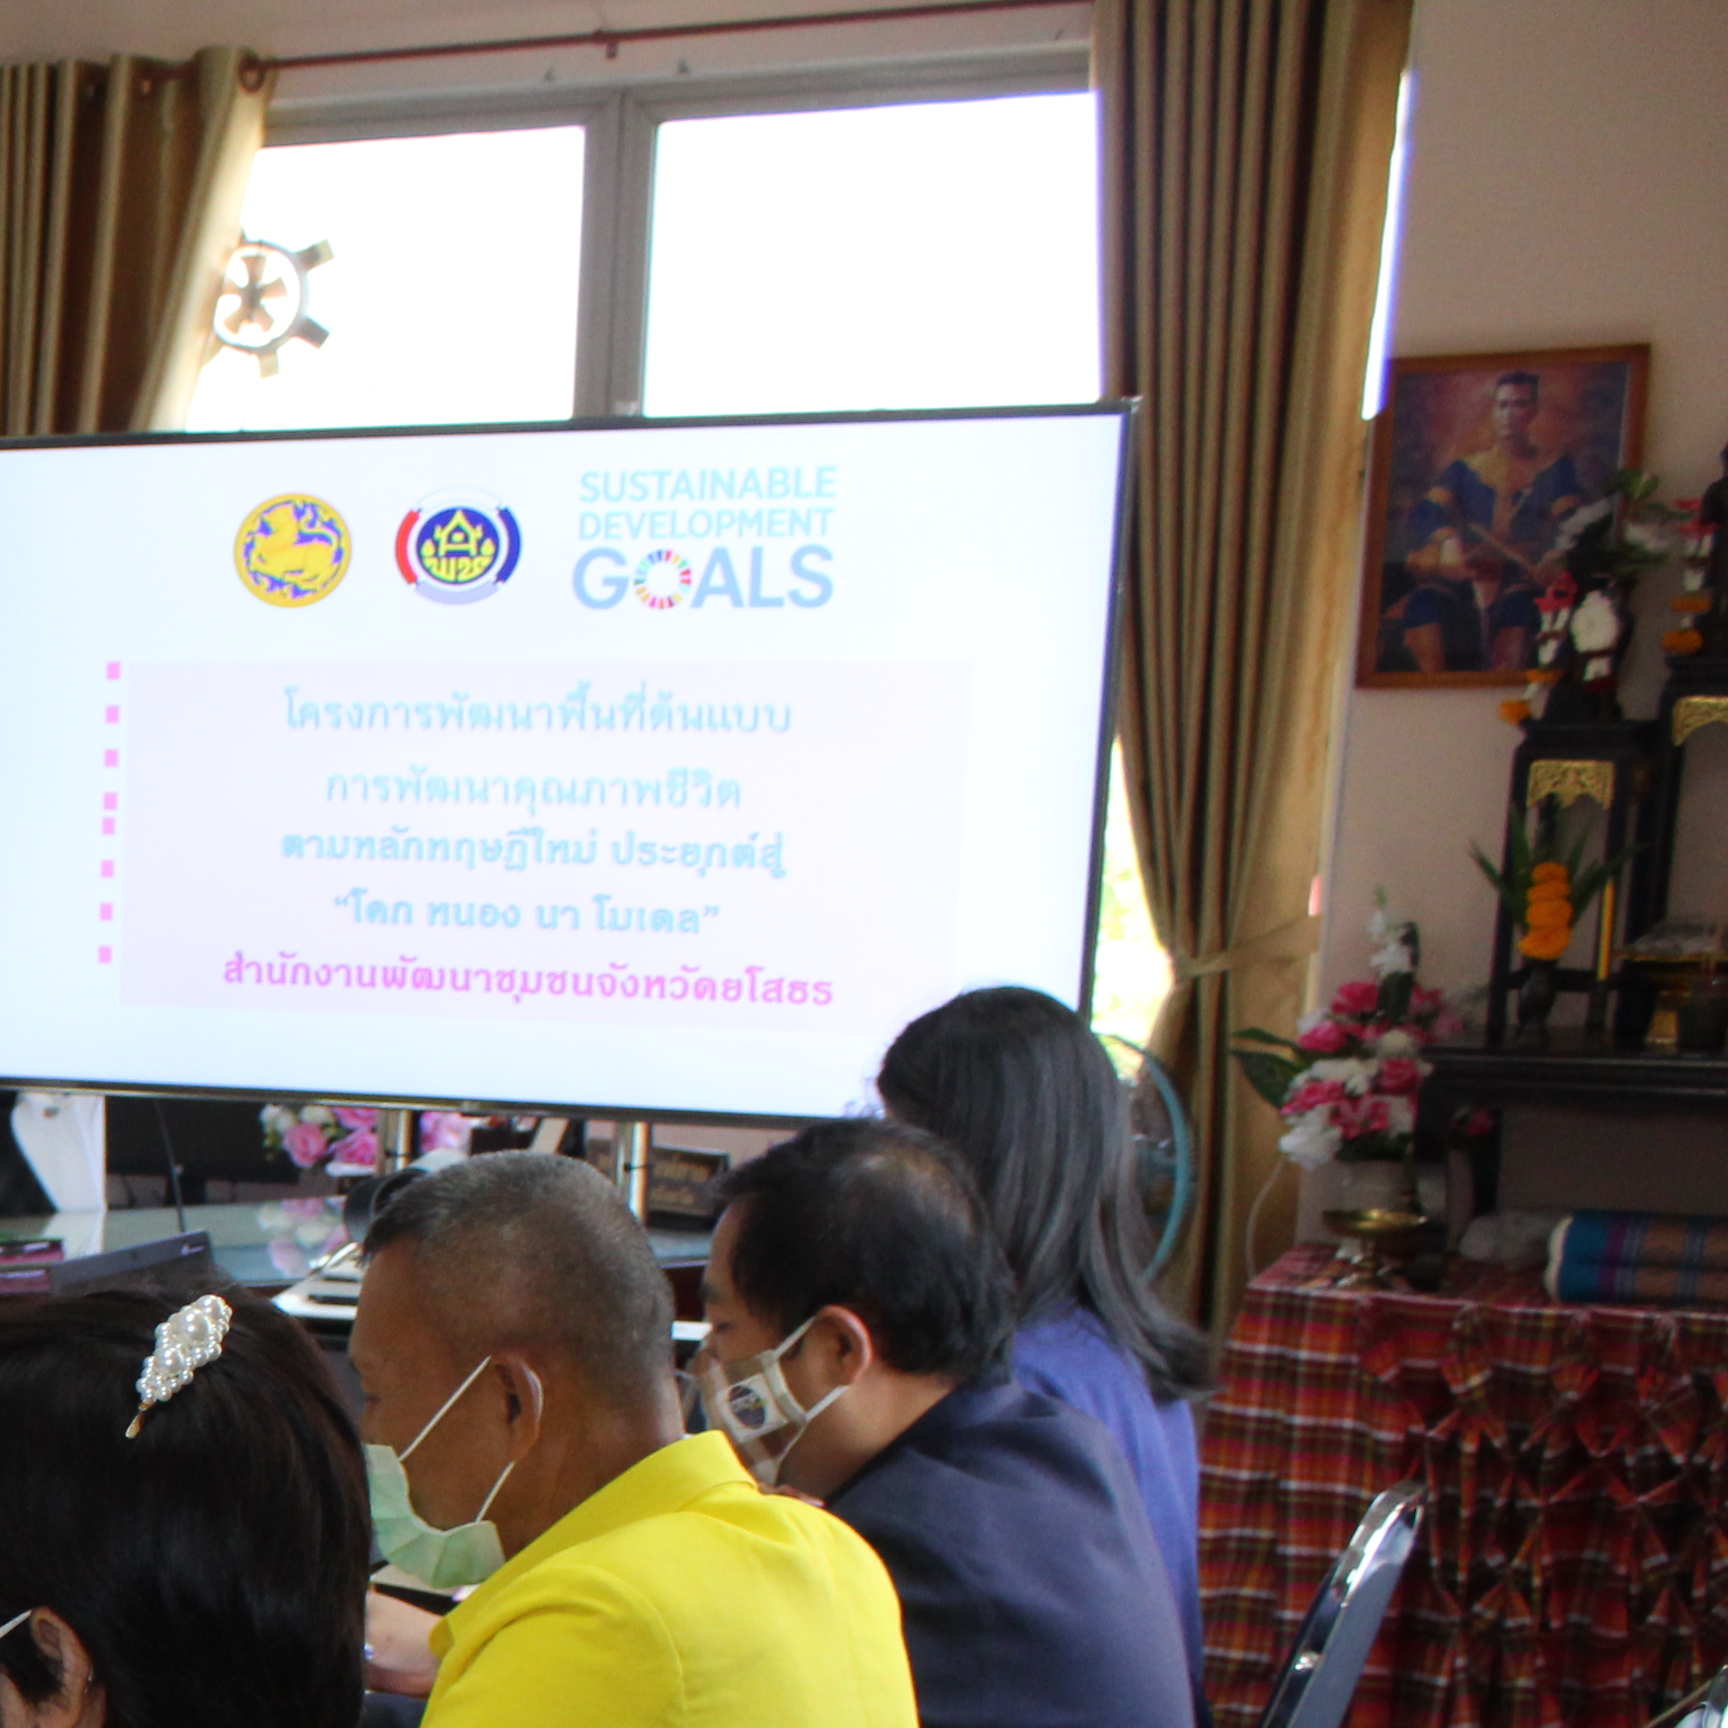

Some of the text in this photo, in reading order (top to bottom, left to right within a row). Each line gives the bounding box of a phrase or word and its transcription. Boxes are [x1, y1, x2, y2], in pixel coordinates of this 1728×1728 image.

[579, 466, 838, 503] SUSTAINABLE
[578, 506, 836, 541] DEVELOPMENT
[572, 543, 834, 610] GOALS
[283, 679, 793, 733] โครงการพัฒนาพื้นที่ต้นแบบ
[325, 763, 743, 815] การพัฒนาคุณภาพชีวิต
[611, 830, 791, 878] ประยุกต์สู่
[427, 898, 522, 929] หนอง
[535, 900, 581, 930] นา
[223, 951, 834, 1006] สำนักงานพัฒนาชุมชนจังหวัดยโสธร
